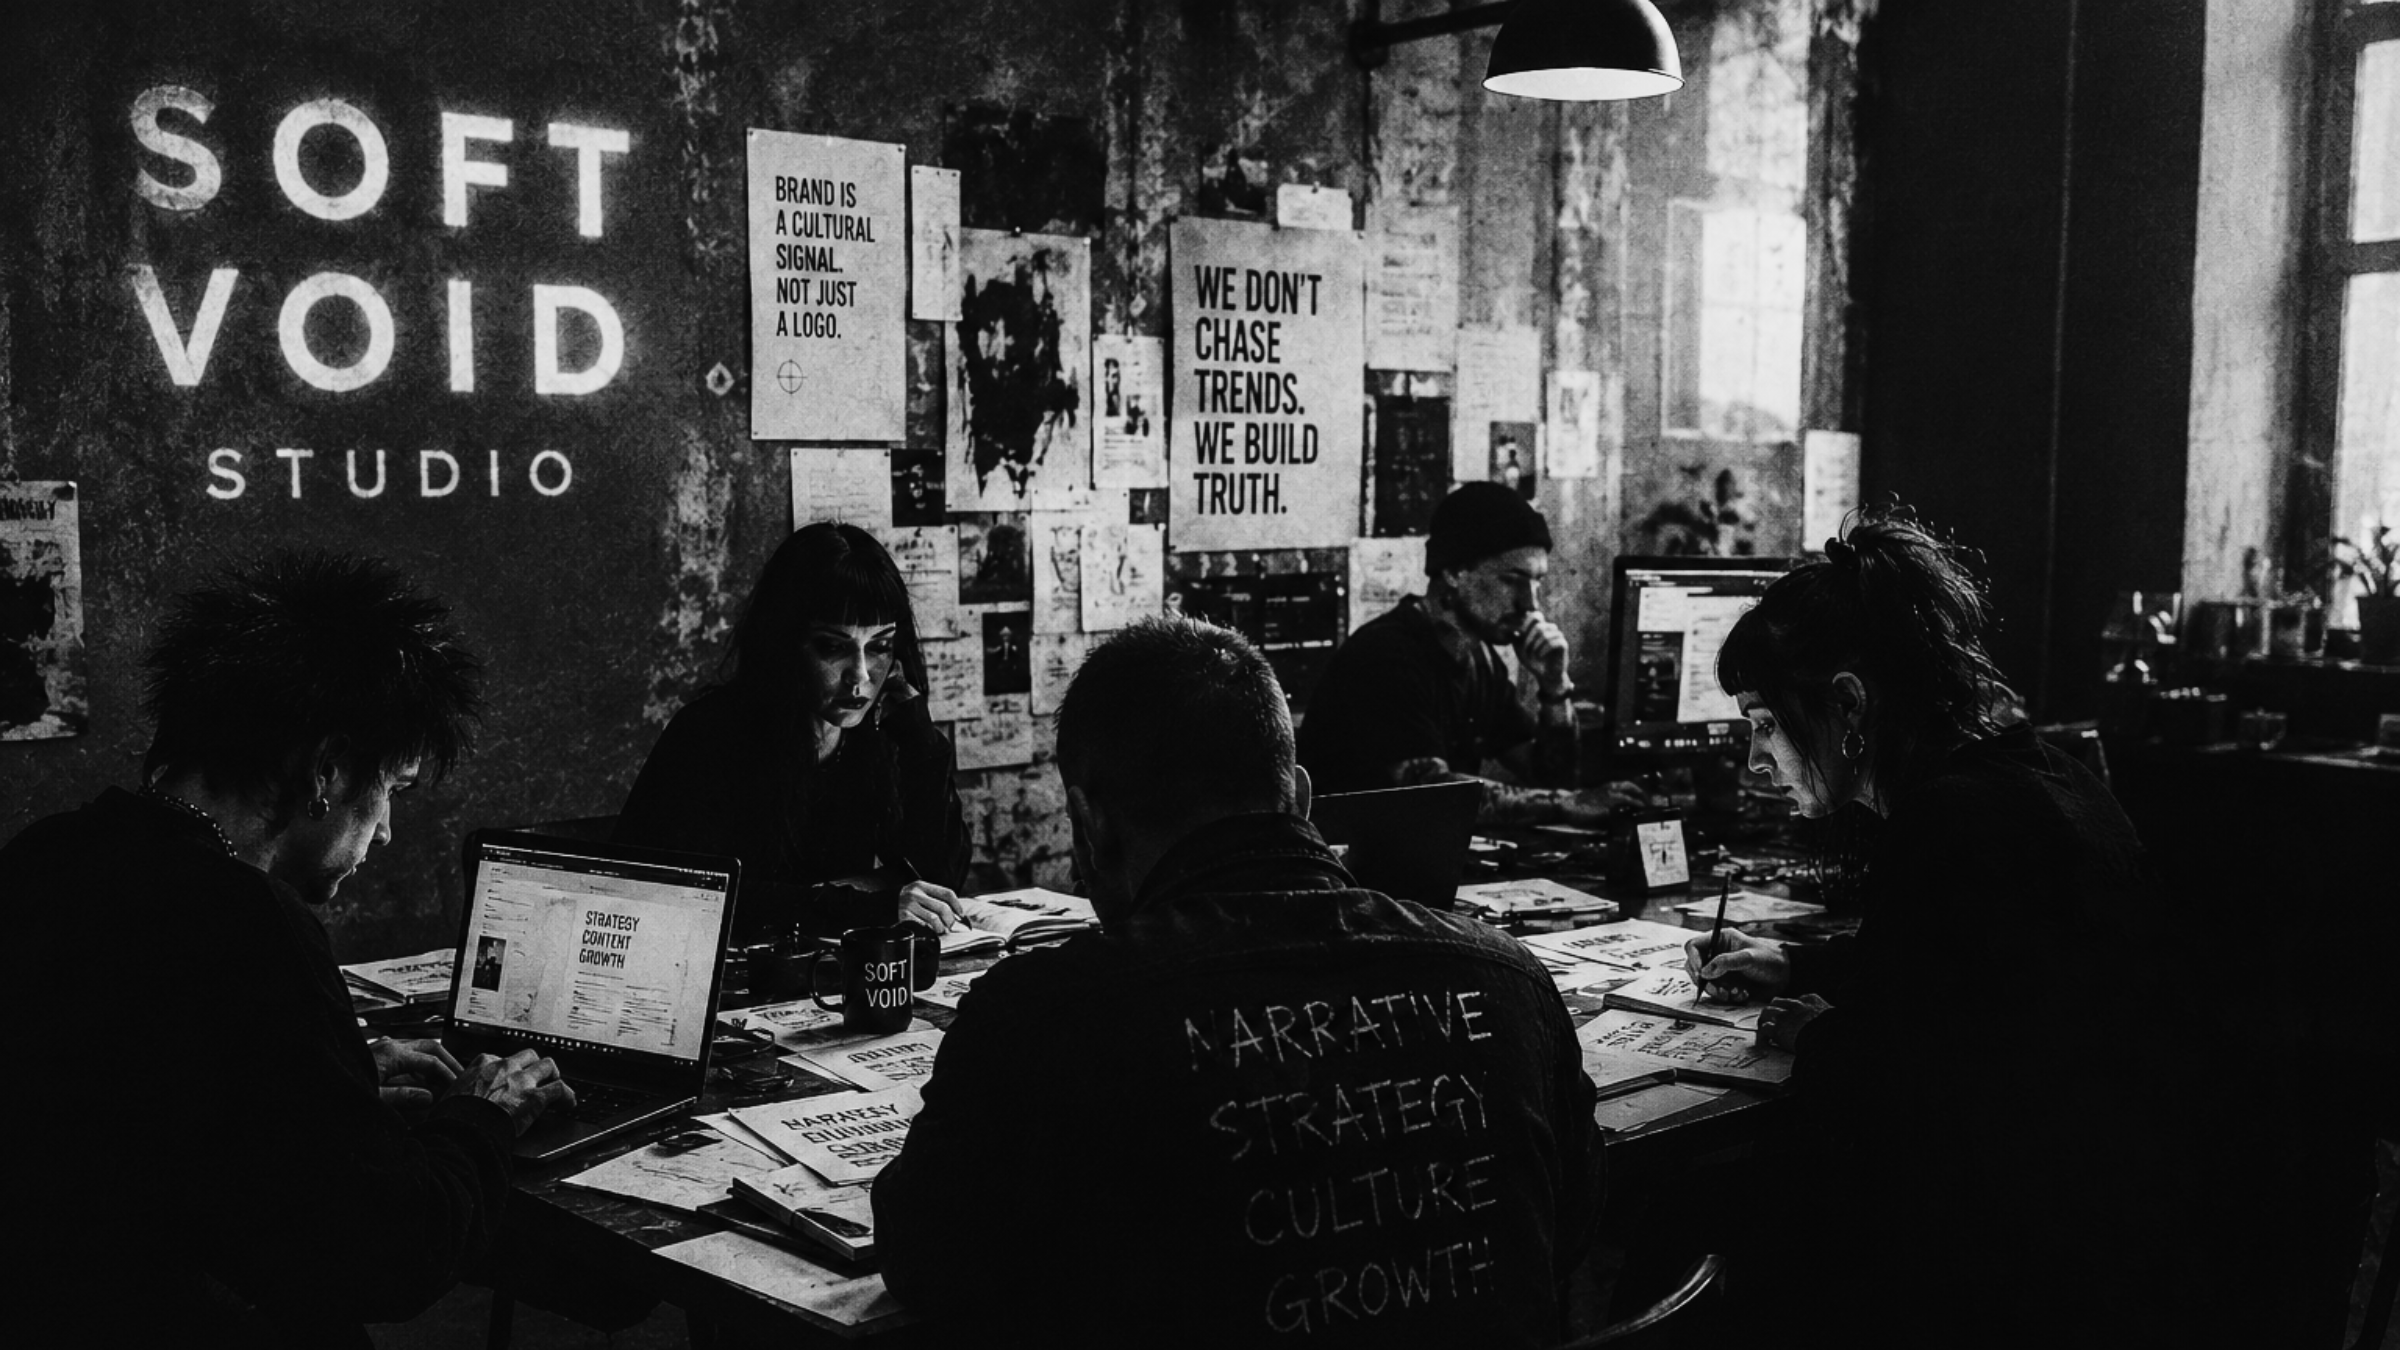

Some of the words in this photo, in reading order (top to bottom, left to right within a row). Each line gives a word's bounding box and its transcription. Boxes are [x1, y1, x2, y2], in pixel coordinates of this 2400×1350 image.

[131, 84, 630, 238] SOFT
[776, 176, 834, 205] BRAND
[841, 182, 856, 208] IS
[776, 210, 787, 235] A
[793, 211, 875, 243] CULTURAL
[776, 244, 843, 272] SIGNAL.
[776, 278, 811, 304] NOT
[817, 280, 857, 307] JUST
[1194, 265, 1236, 310] WE
[1246, 269, 1322, 315] DON'T
[132, 264, 625, 395] VOID
[776, 311, 788, 336] A
[793, 312, 842, 338] LOGO.
[1194, 316, 1281, 363] CHASE
[1194, 369, 1305, 415] TRENDS.
[1194, 422, 1235, 464] WE
[1245, 423, 1318, 465] BUILD
[206, 448, 573, 499] STUDIO
[1193, 473, 1287, 515] TRUTH.
[585, 910, 640, 932] STRATEGY
[579, 948, 626, 969] GROWTH
[865, 959, 907, 982] SOFT
[865, 985, 908, 1009] VOID
[1184, 989, 1492, 1070] NARRATIVE
[1209, 1072, 1489, 1161] STRATEGY
[1244, 1154, 1496, 1247] CULTURE
[1265, 1236, 1495, 1334] GROWTH
